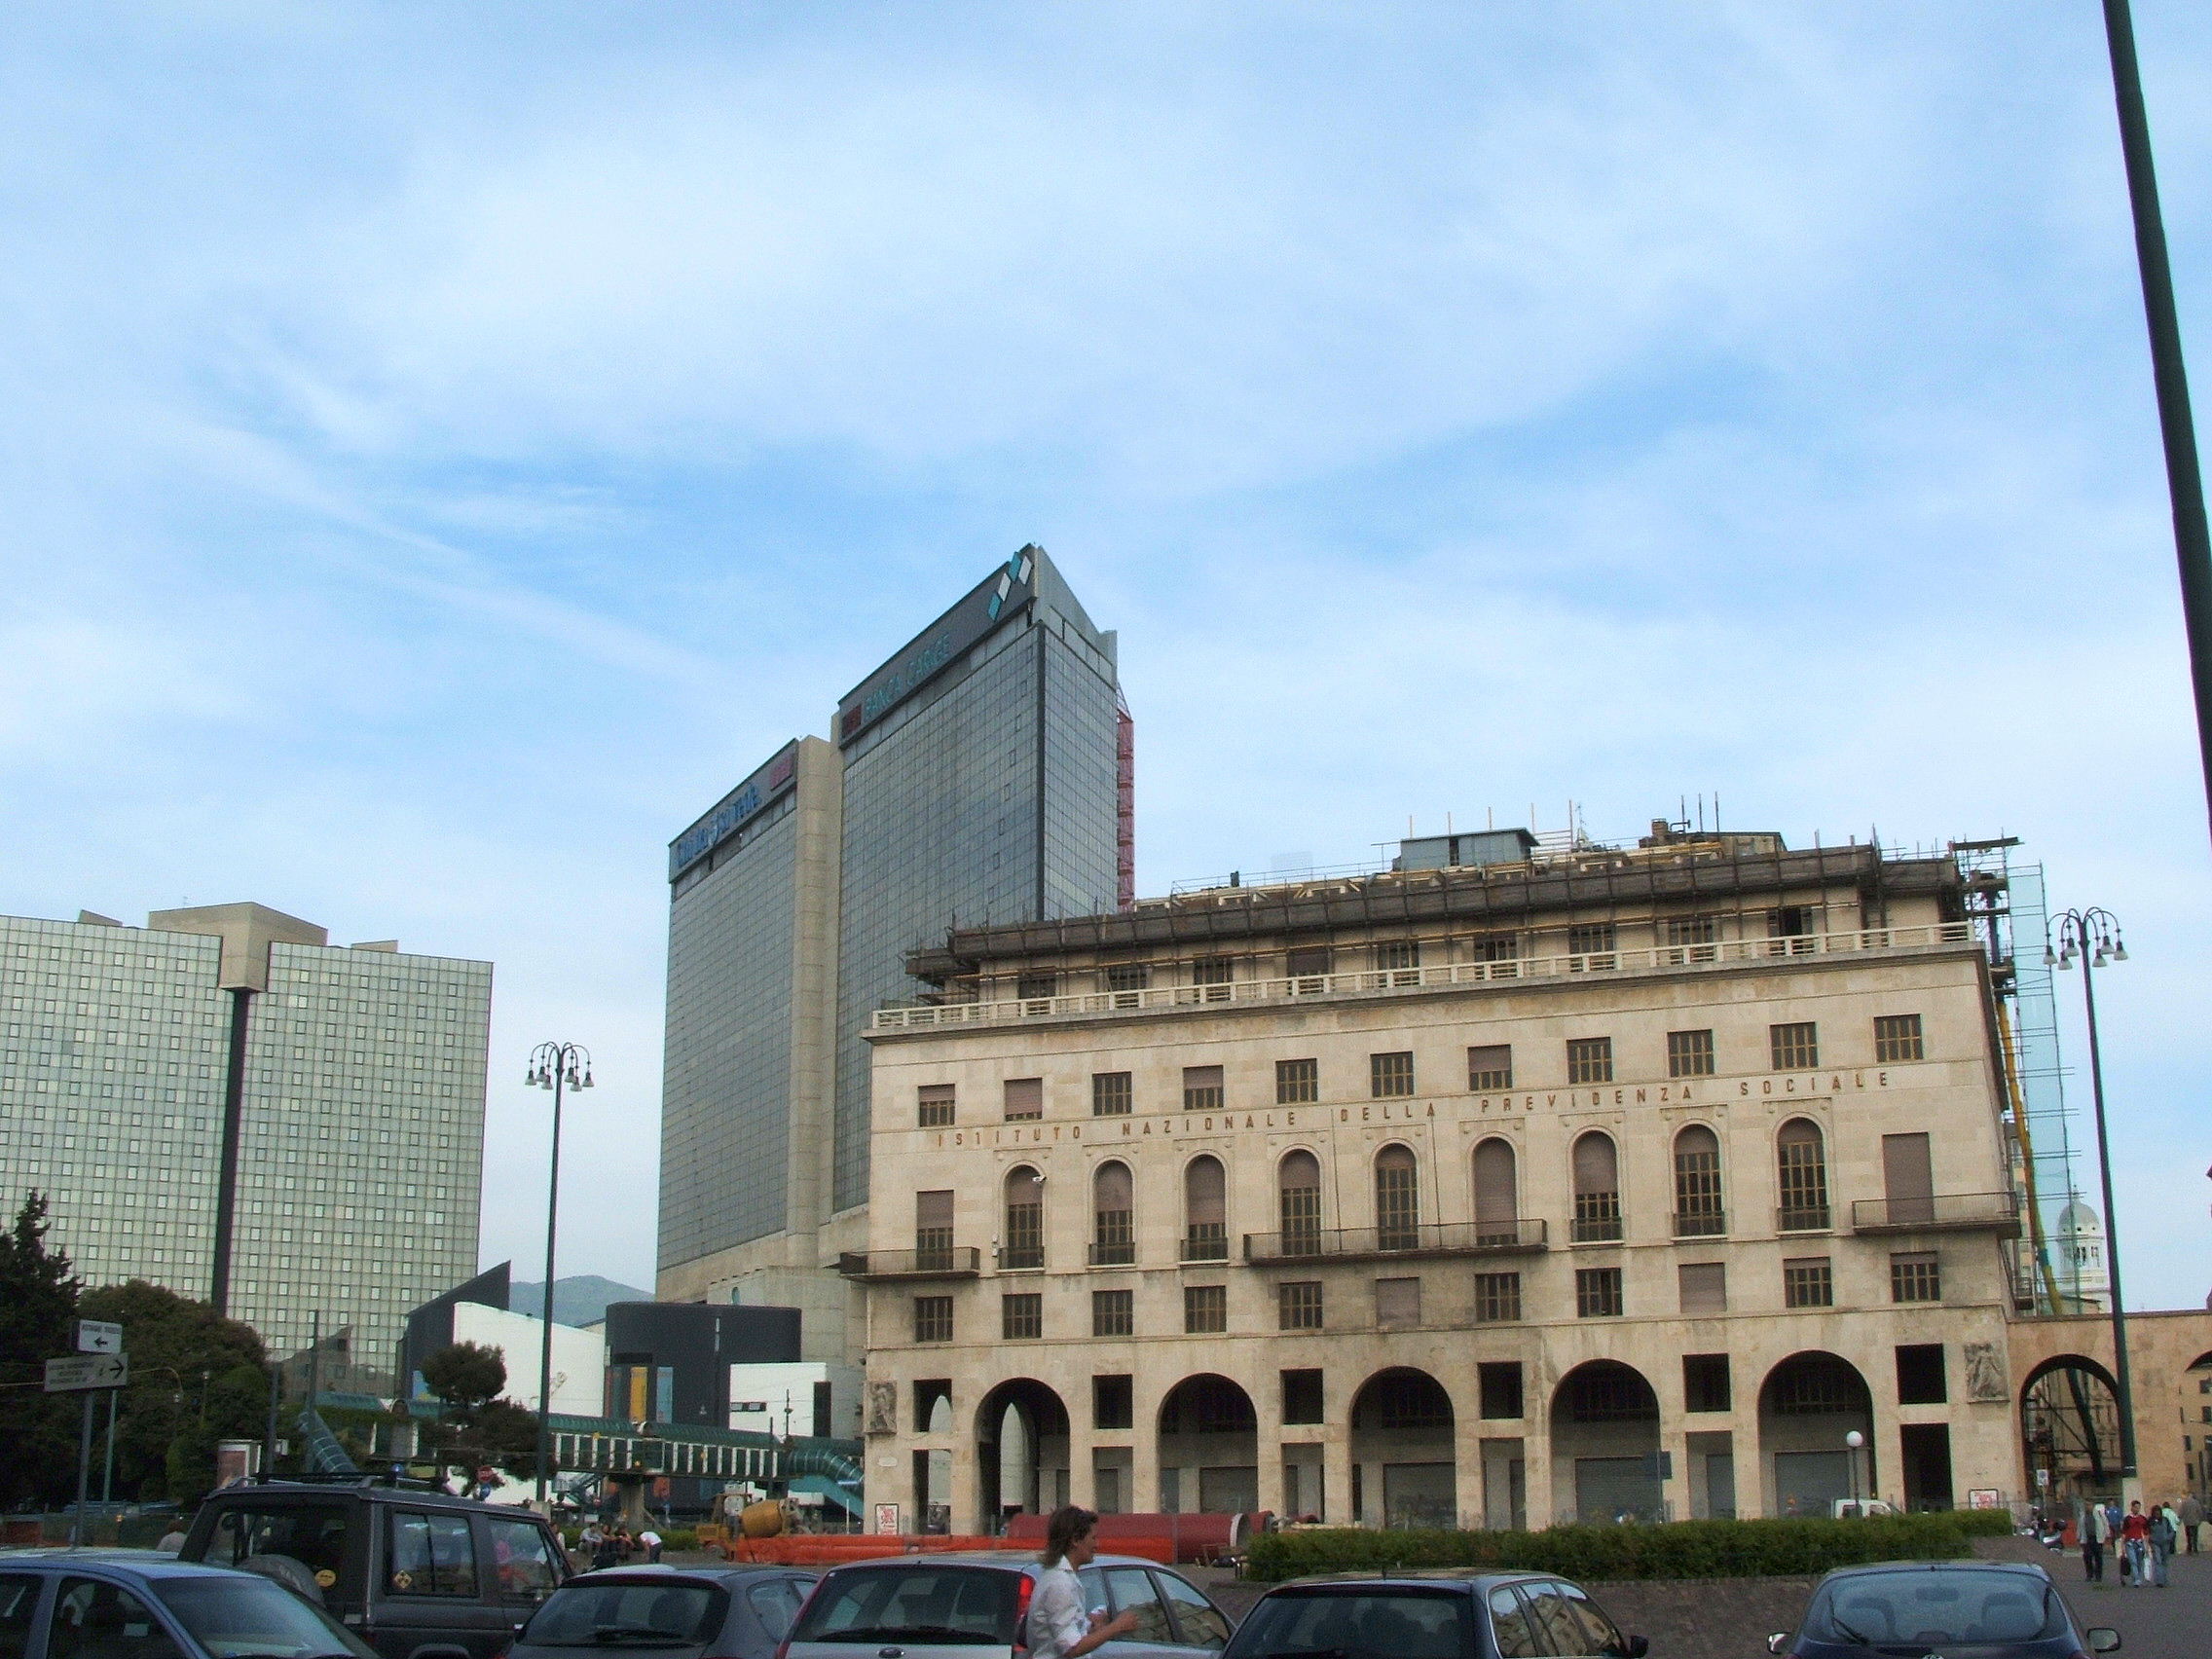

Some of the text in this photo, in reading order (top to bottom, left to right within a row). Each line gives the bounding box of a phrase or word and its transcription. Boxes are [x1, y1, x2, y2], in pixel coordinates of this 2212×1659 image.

[938, 1072, 1887, 1147] ISTITUTO NAZIONALE DELLA PREVIDENZA SOCIALE
